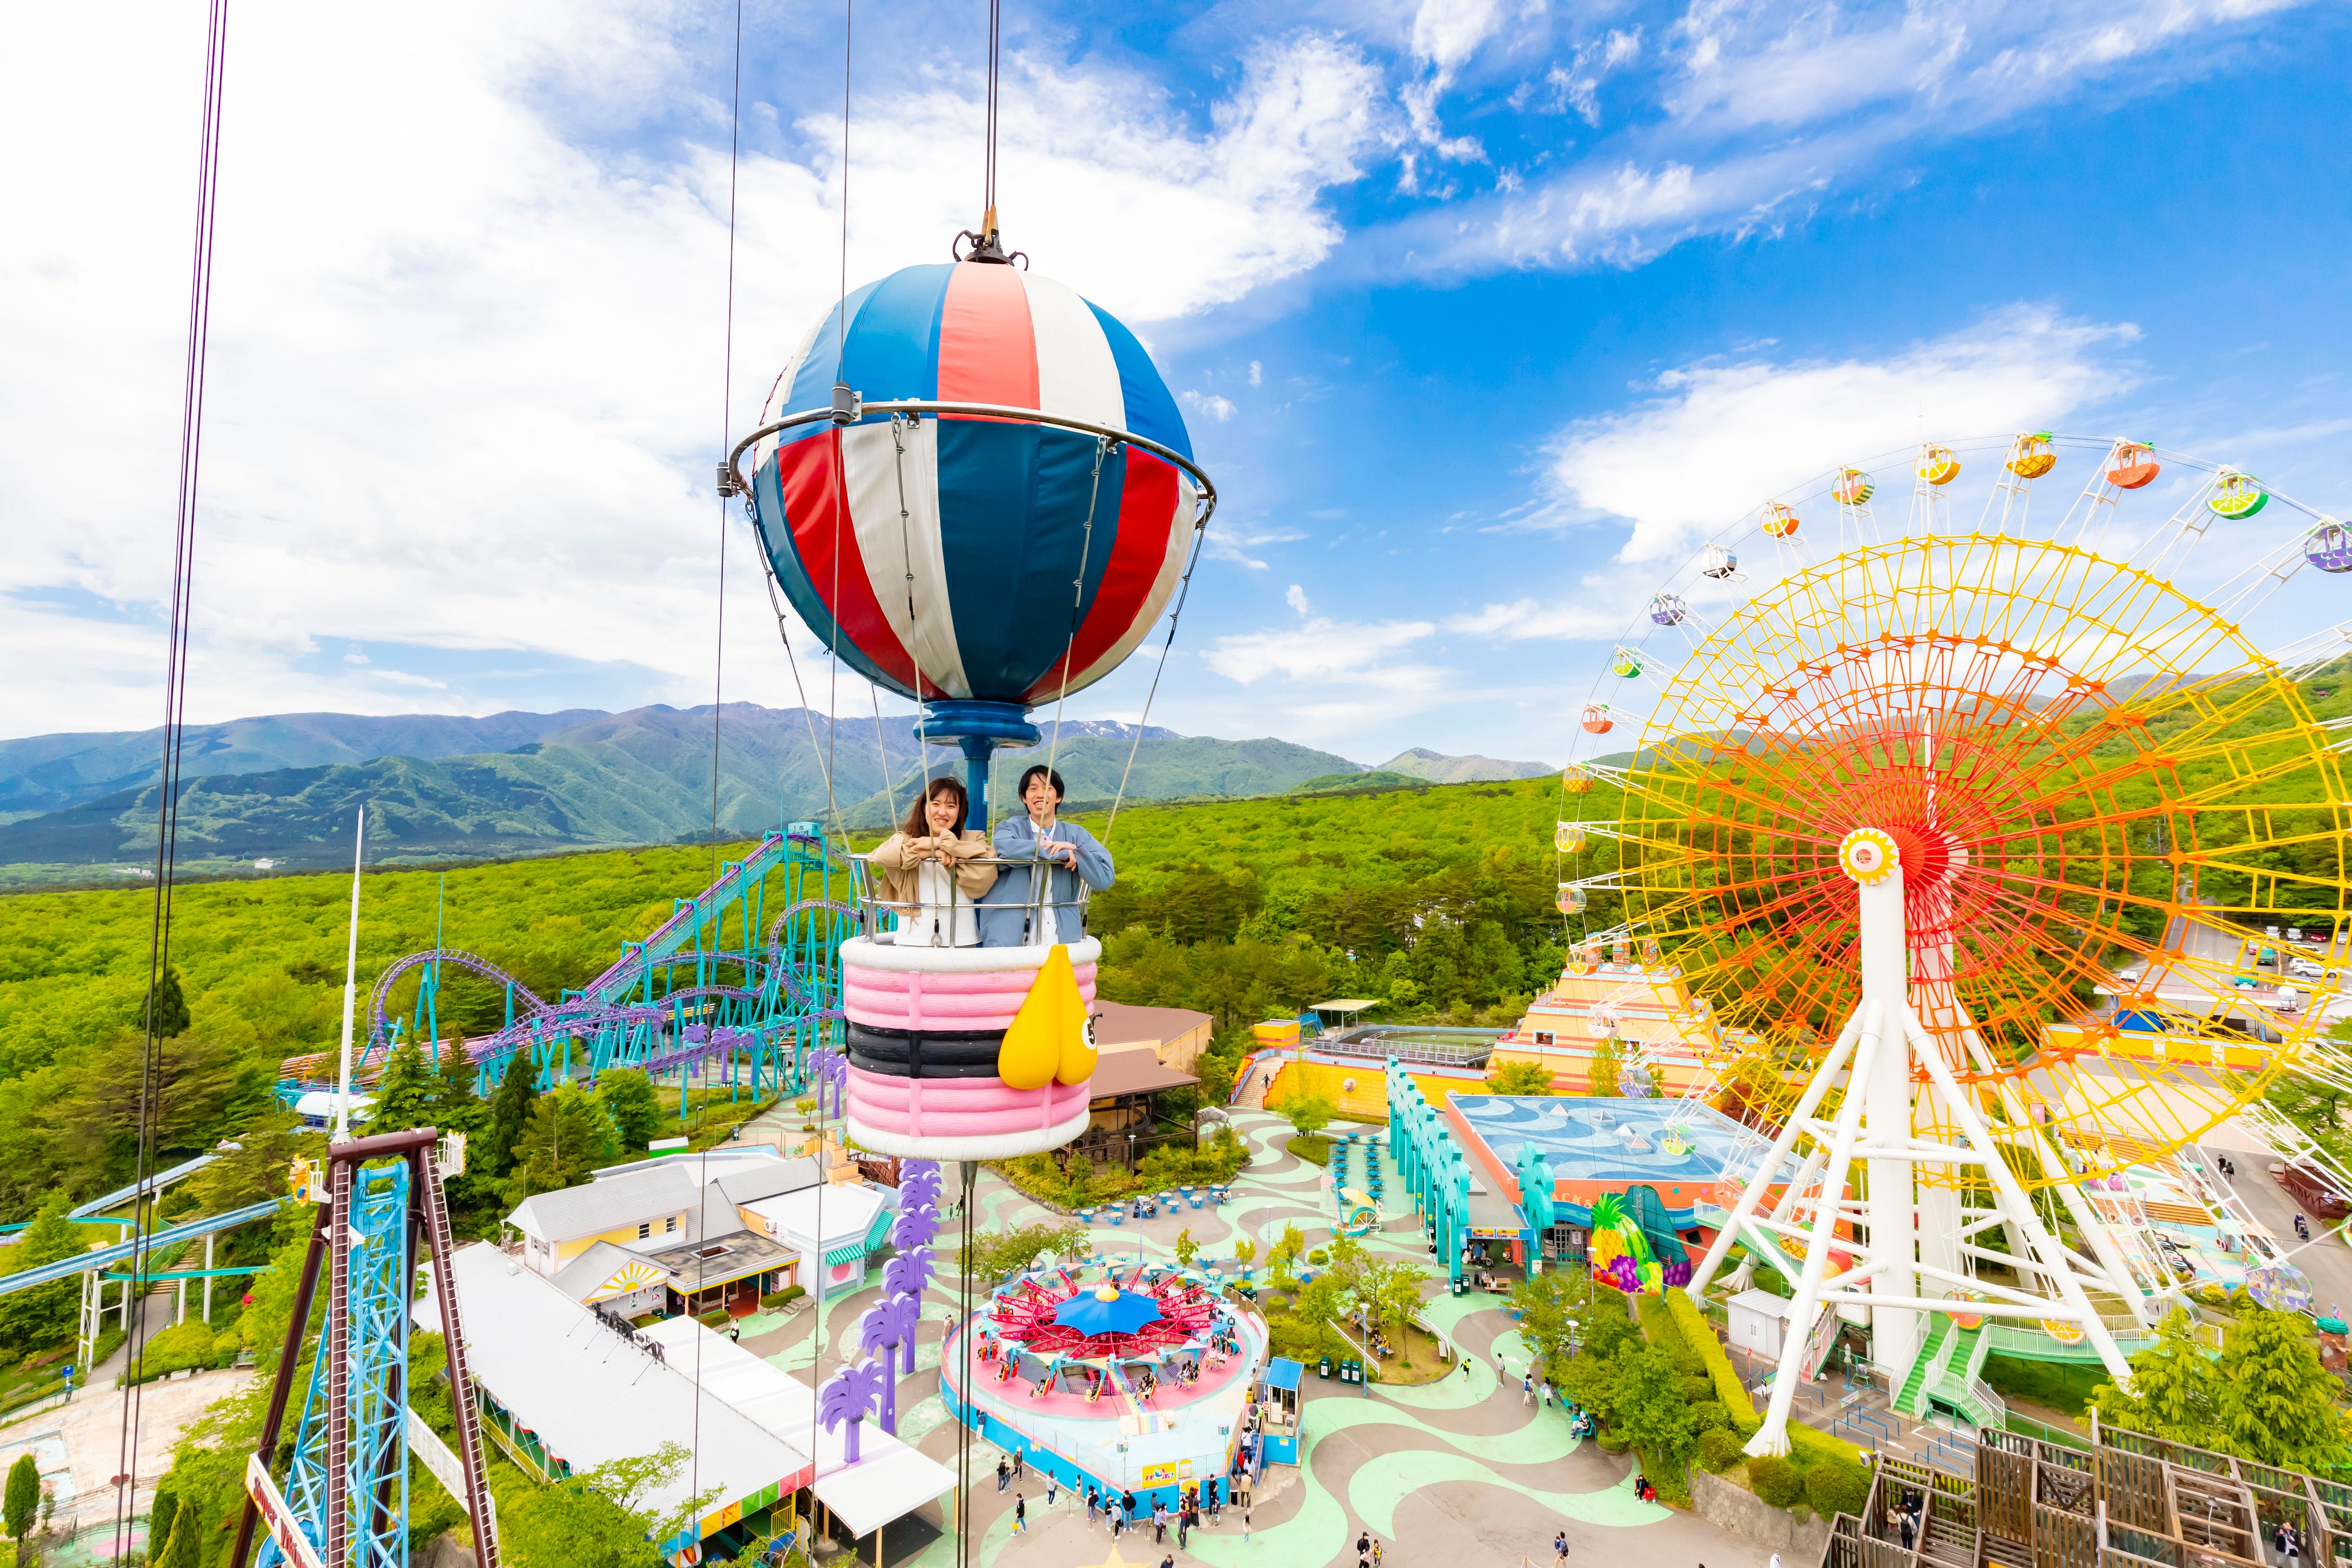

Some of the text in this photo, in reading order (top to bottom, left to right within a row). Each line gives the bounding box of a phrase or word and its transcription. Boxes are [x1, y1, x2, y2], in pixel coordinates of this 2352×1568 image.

[1087, 1023, 1095, 1045] 5
[253, 1476, 309, 1568] Super Vikin
